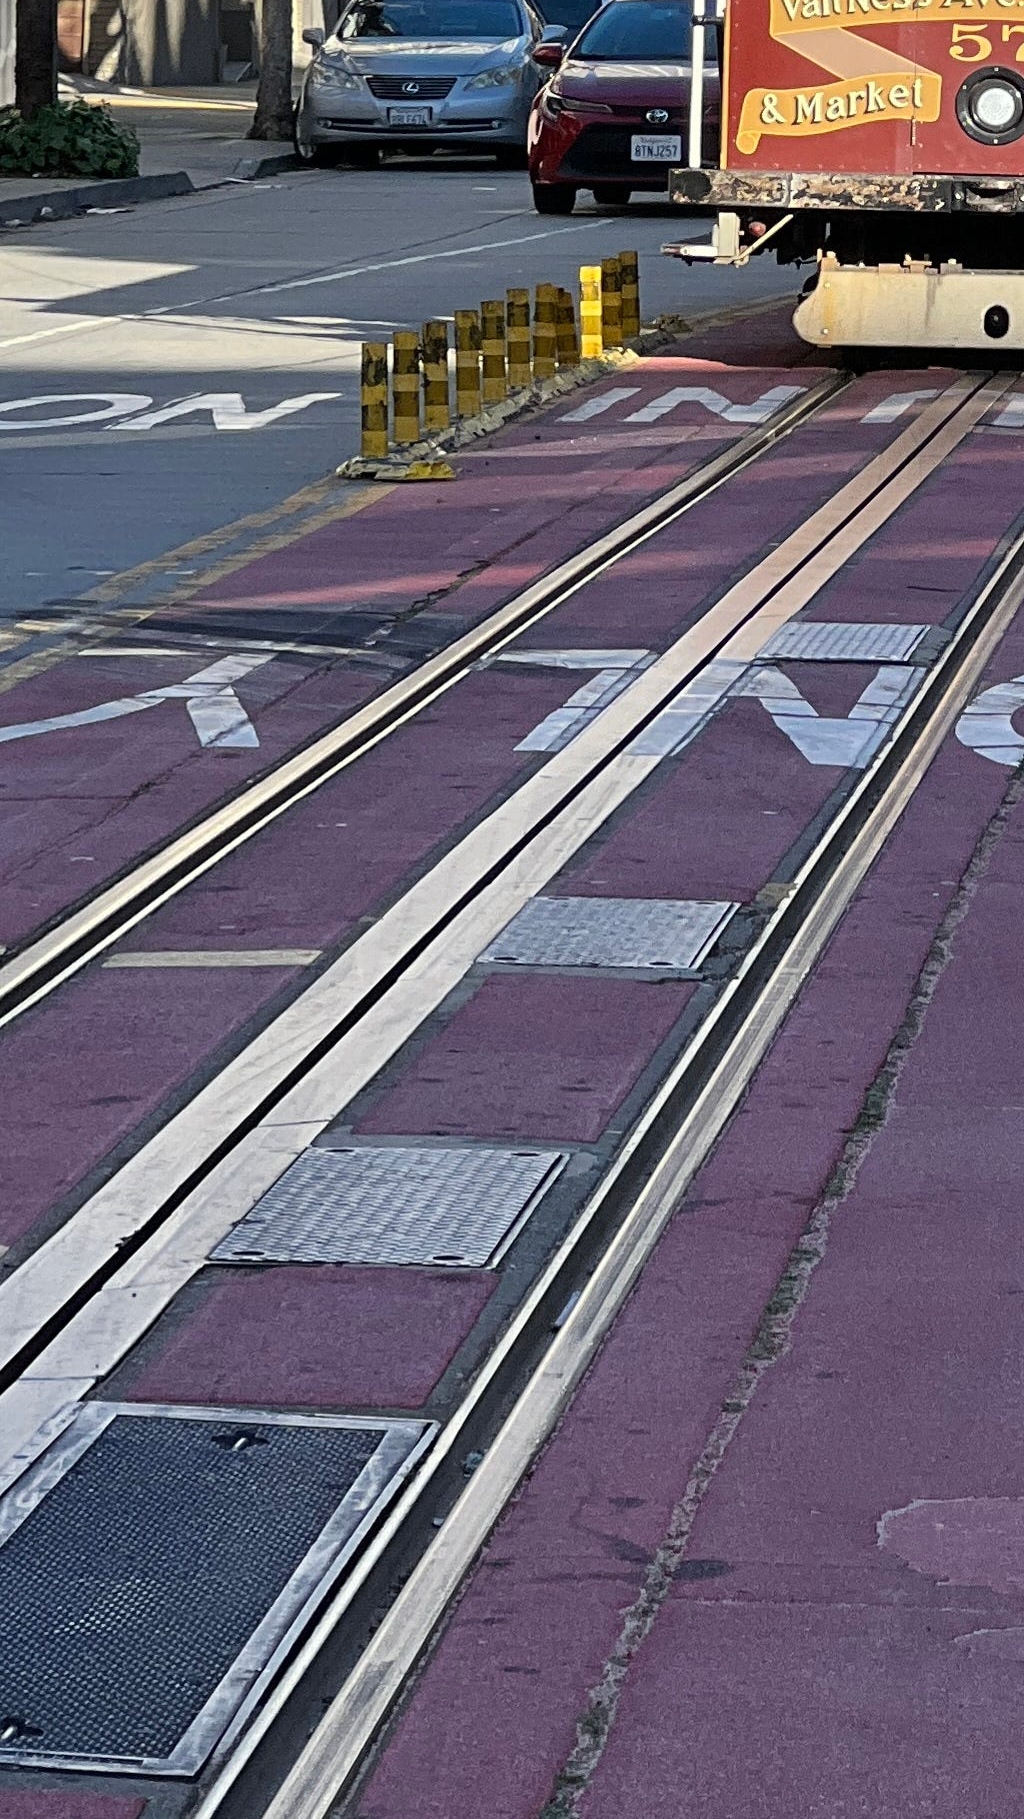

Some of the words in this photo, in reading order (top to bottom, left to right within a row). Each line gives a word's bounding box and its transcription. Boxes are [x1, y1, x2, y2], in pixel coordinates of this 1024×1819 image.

[759, 94, 780, 125] &
[794, 80, 923, 125] Market
[634, 144, 678, 158] 8TNJ257
